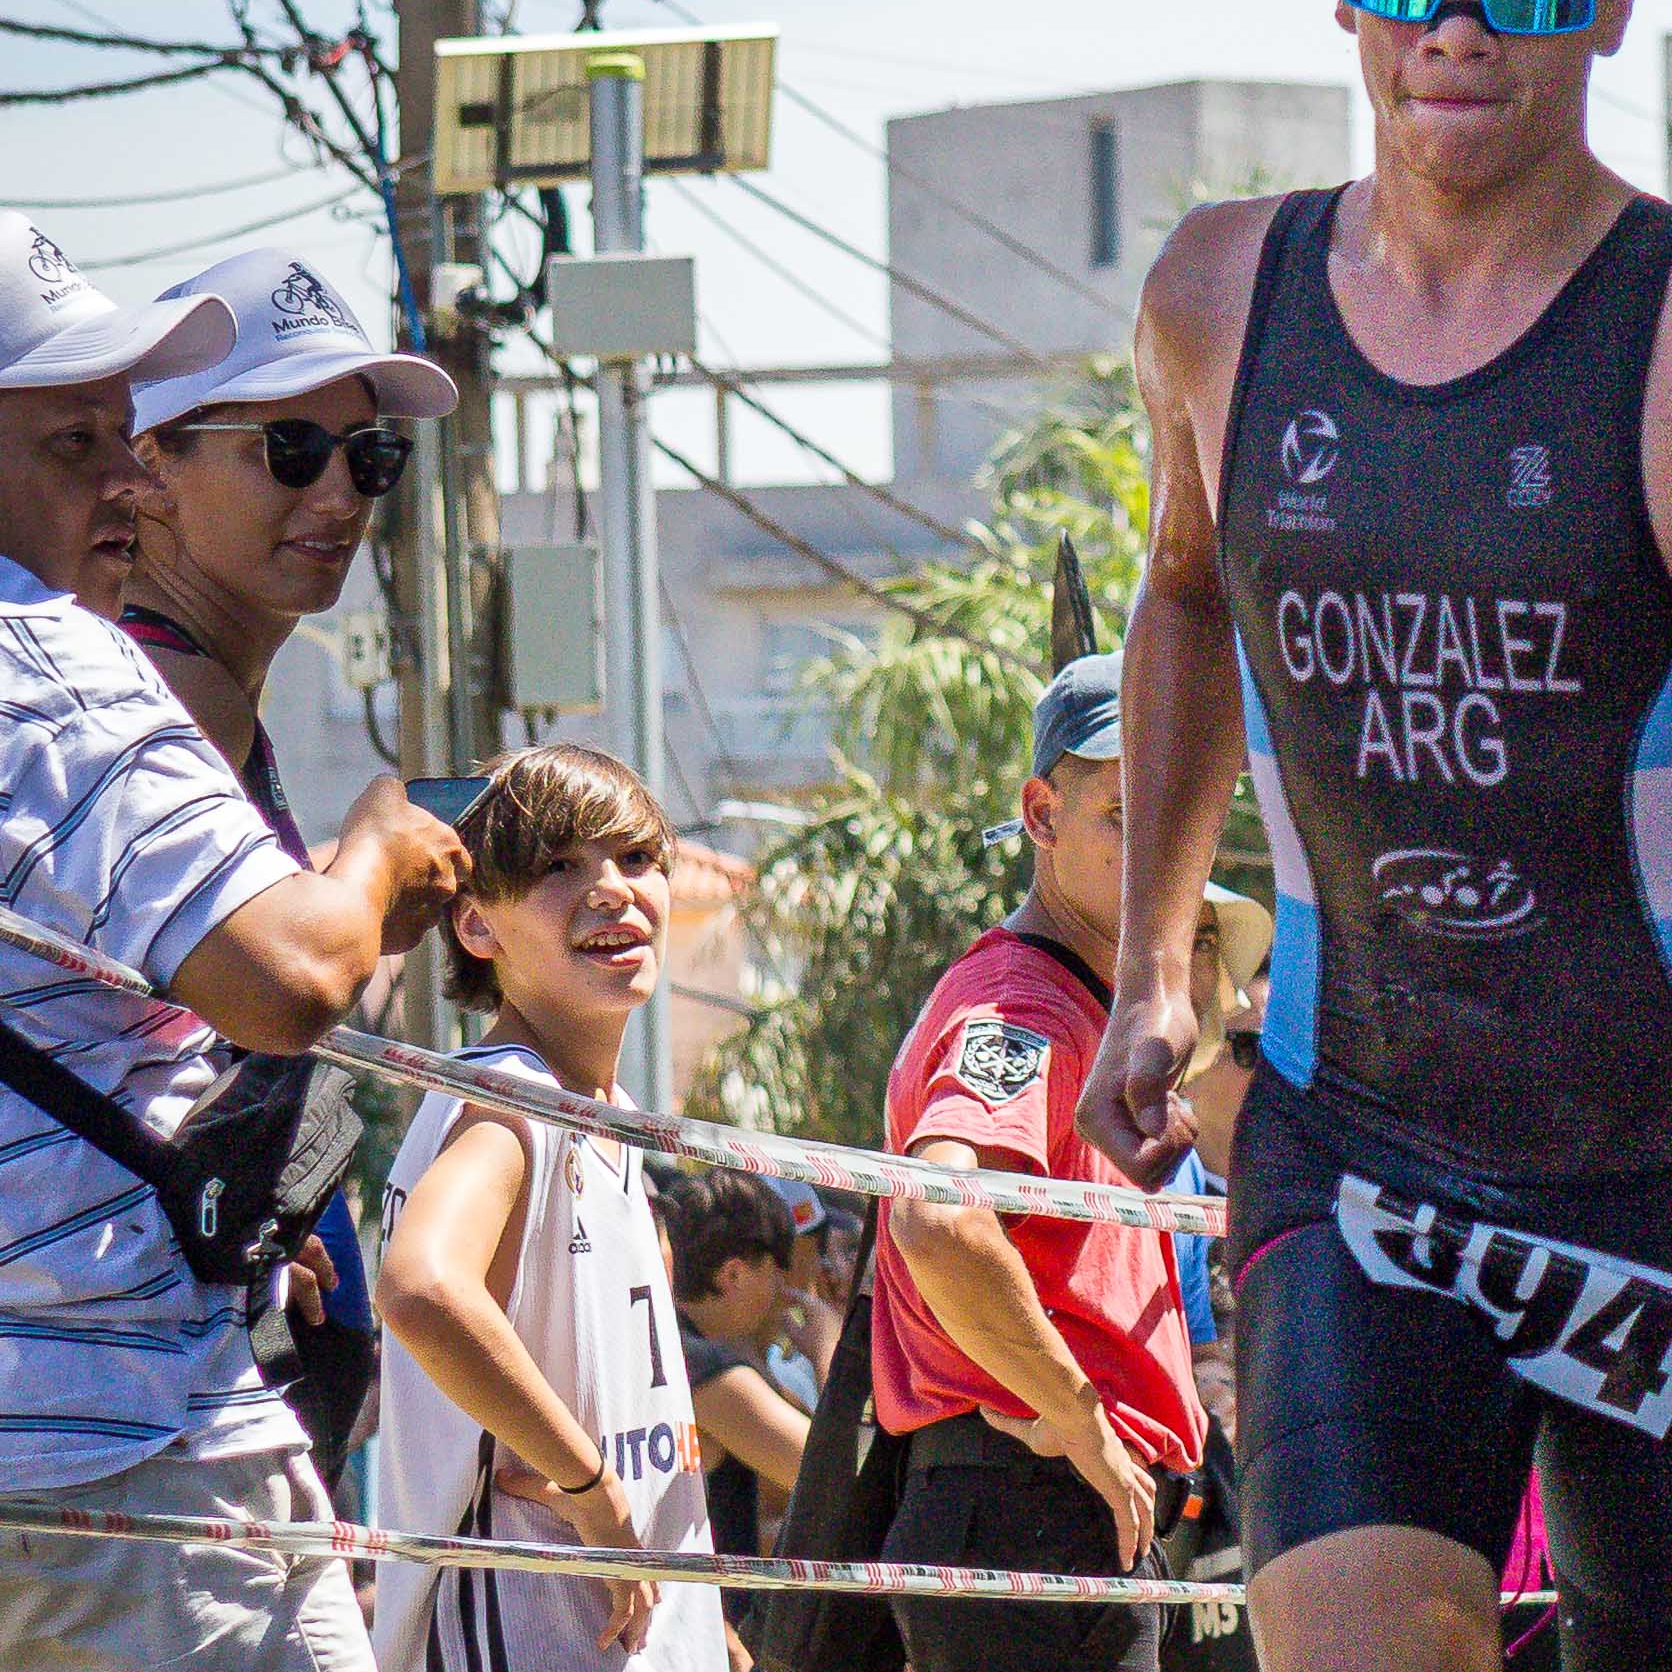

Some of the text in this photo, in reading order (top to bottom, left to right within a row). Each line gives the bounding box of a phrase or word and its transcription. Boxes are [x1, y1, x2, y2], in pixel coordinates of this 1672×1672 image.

[272, 314, 329, 334] Mundo
[1278, 590, 1581, 693] GONZALEZ
[1357, 691, 1507, 786] ARG
